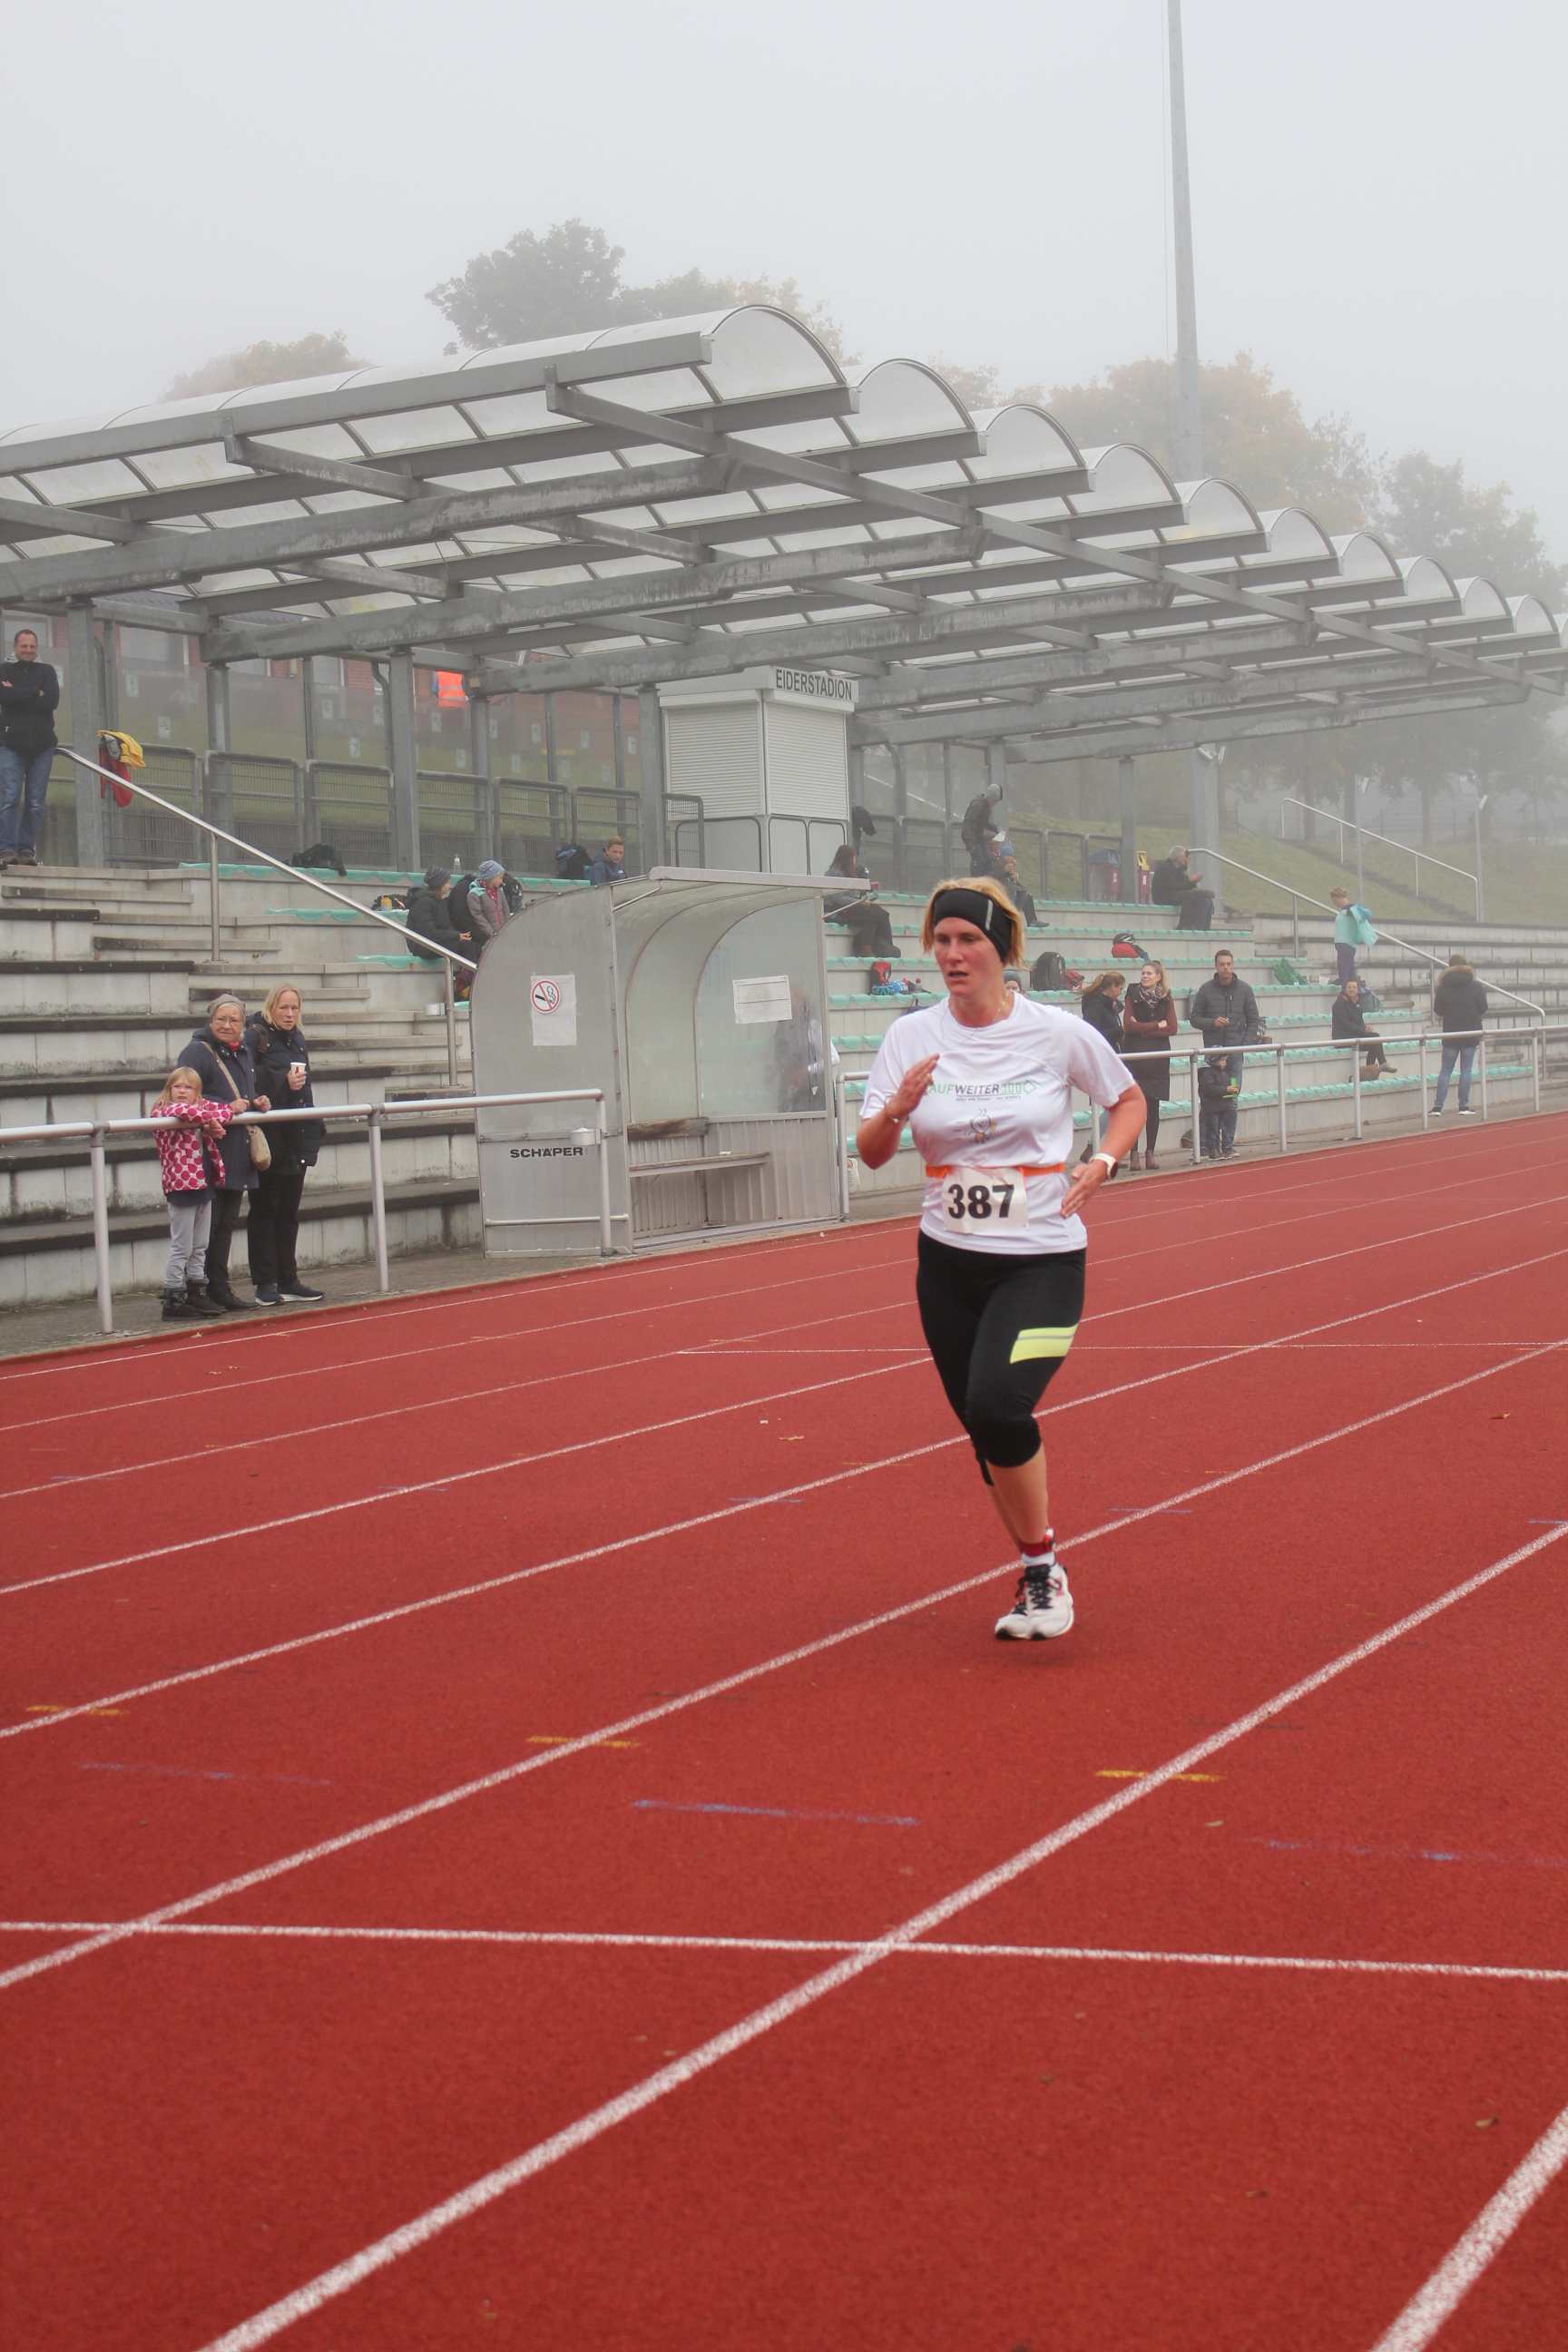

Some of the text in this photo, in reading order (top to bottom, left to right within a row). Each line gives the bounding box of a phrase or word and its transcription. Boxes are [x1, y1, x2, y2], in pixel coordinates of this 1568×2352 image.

[776, 669, 852, 701] EIDERSTADION
[509, 1146, 583, 1159] SCHÄPER
[947, 1183, 1014, 1220] 387
